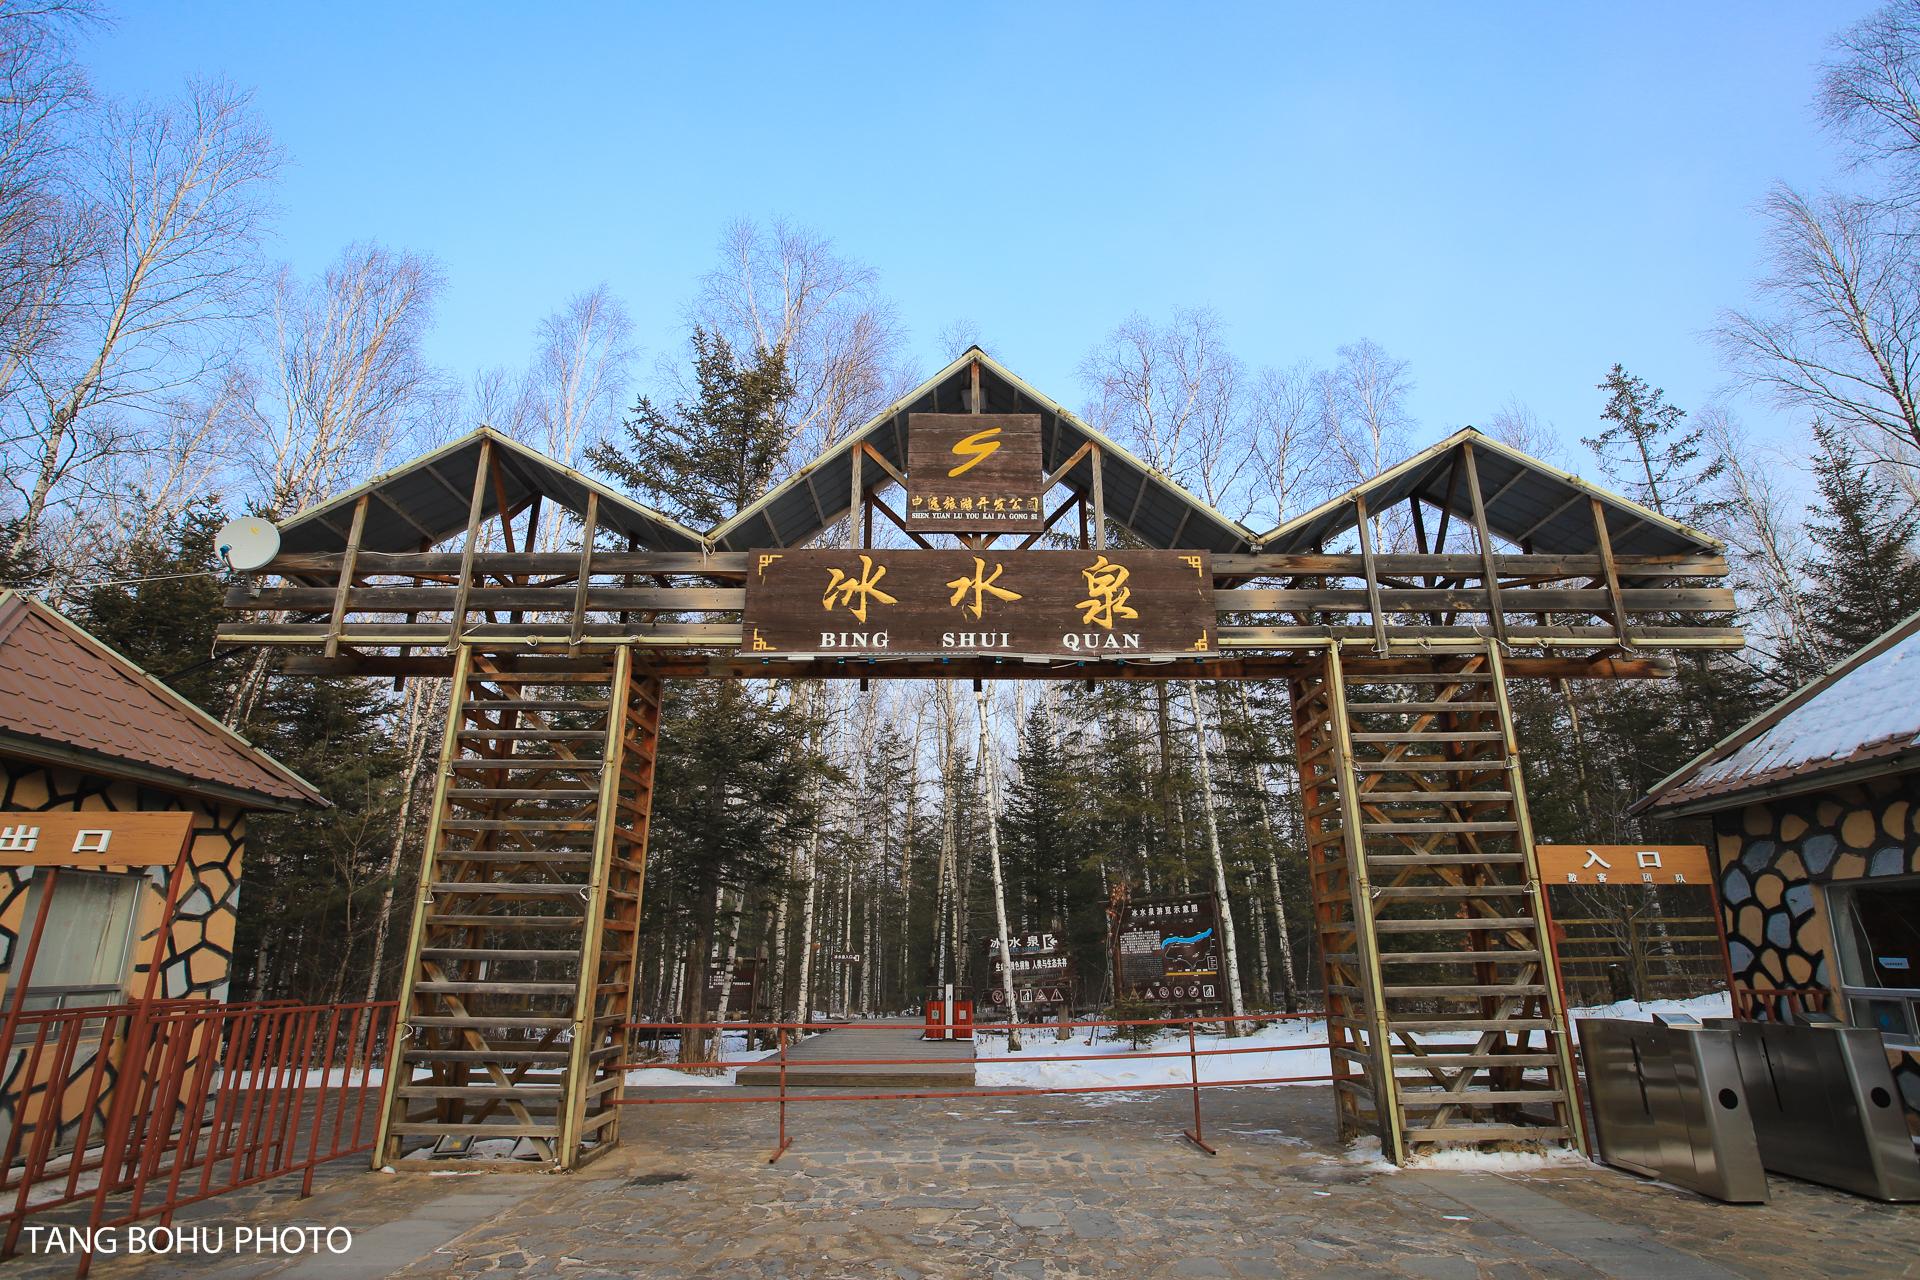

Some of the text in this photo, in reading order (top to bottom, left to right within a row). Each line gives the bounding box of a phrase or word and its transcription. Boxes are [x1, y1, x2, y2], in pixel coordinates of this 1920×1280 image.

[911, 512, 1038, 520] SHEN YUAN LU YOU KAI FA GONG SI
[821, 554, 1139, 629] 冰水泉
[820, 632, 1141, 651] BING SHUI QUAN
[0, 824, 113, 853] 出口
[1583, 849, 1662, 869] 入口
[990, 935, 1040, 948] 冰水泉
